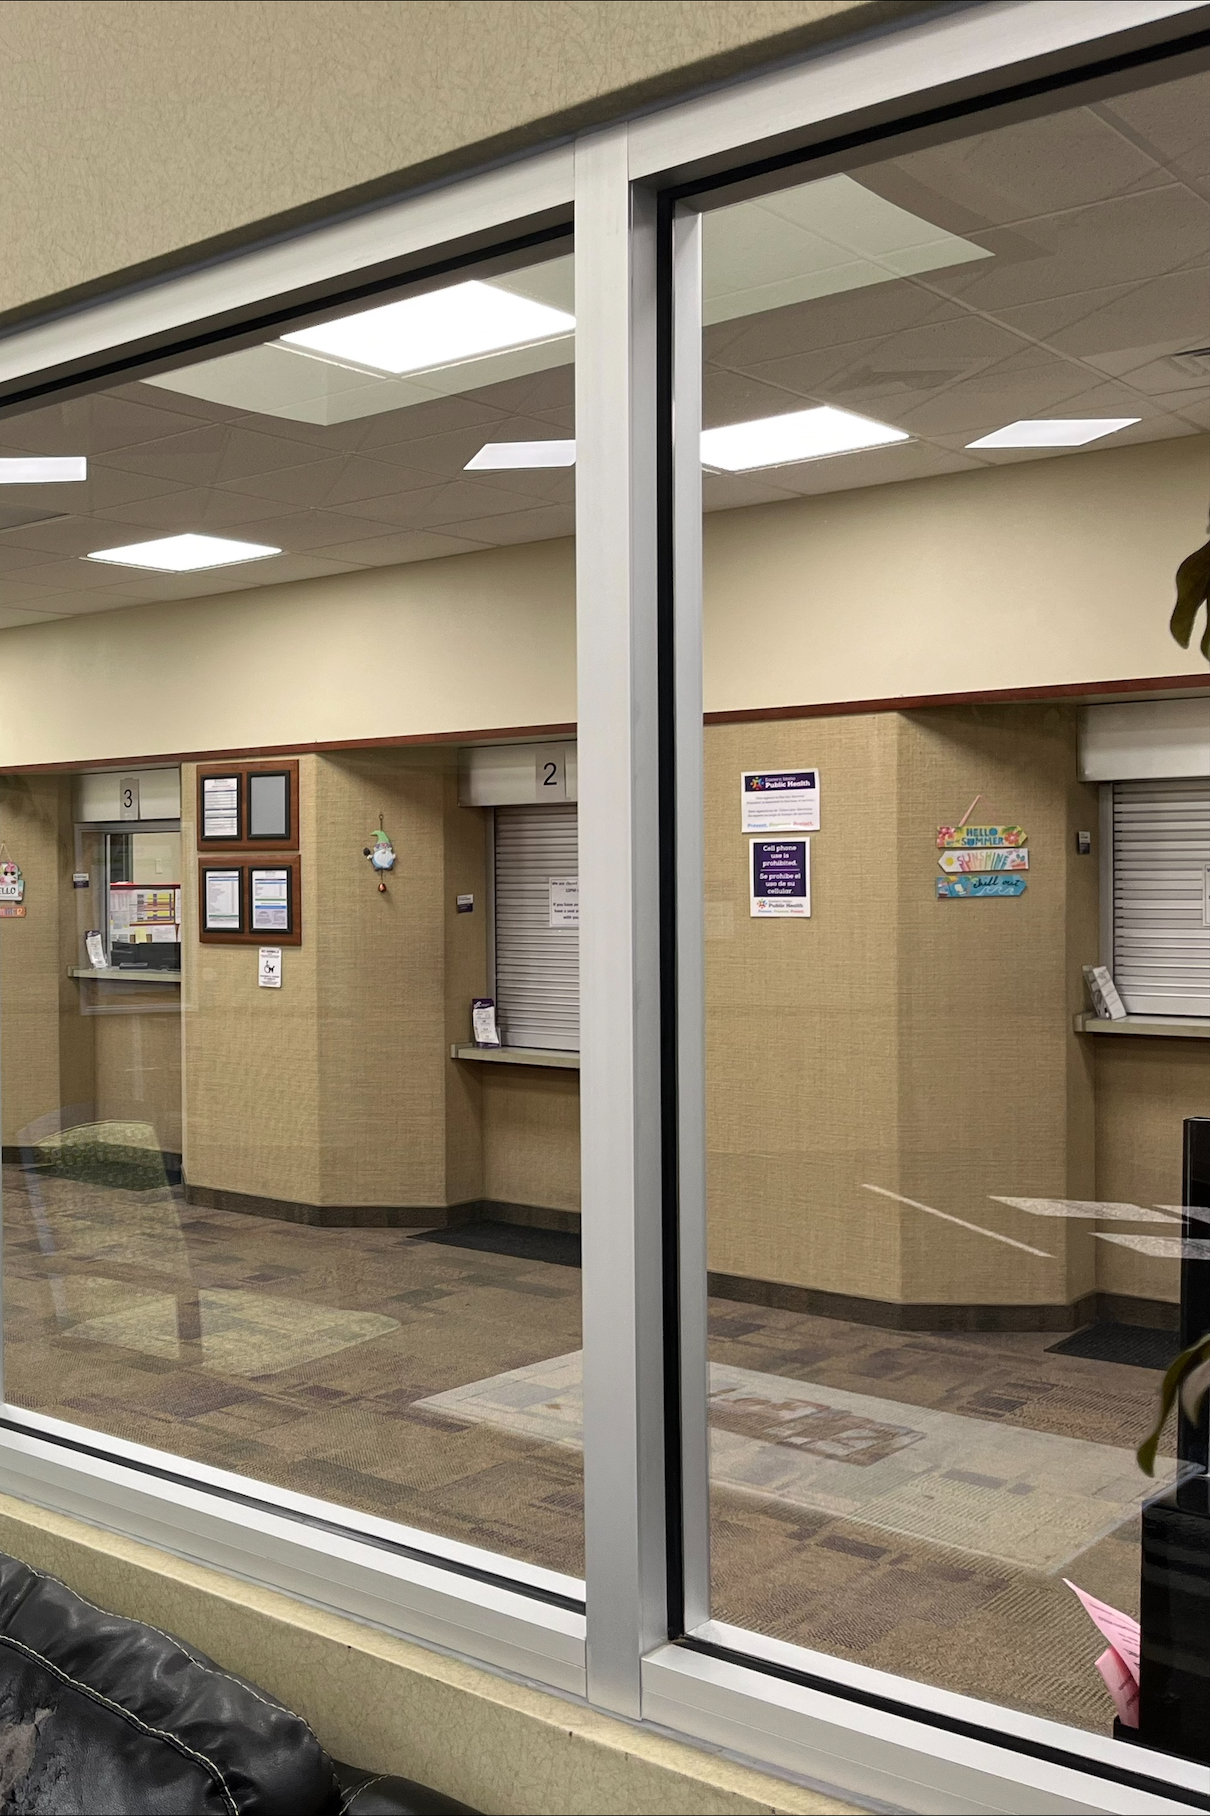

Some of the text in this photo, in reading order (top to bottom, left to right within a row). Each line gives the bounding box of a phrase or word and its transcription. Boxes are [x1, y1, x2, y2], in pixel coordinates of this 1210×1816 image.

[543, 762, 557, 786] 2
[123, 789, 133, 808] 3
[966, 827, 998, 836] HELLO
[961, 837, 1004, 846] SUMMER
[762, 860, 797, 868] prohibited.
[957, 852, 1009, 872] SUNSHINE
[1002, 878, 1024, 887] out
